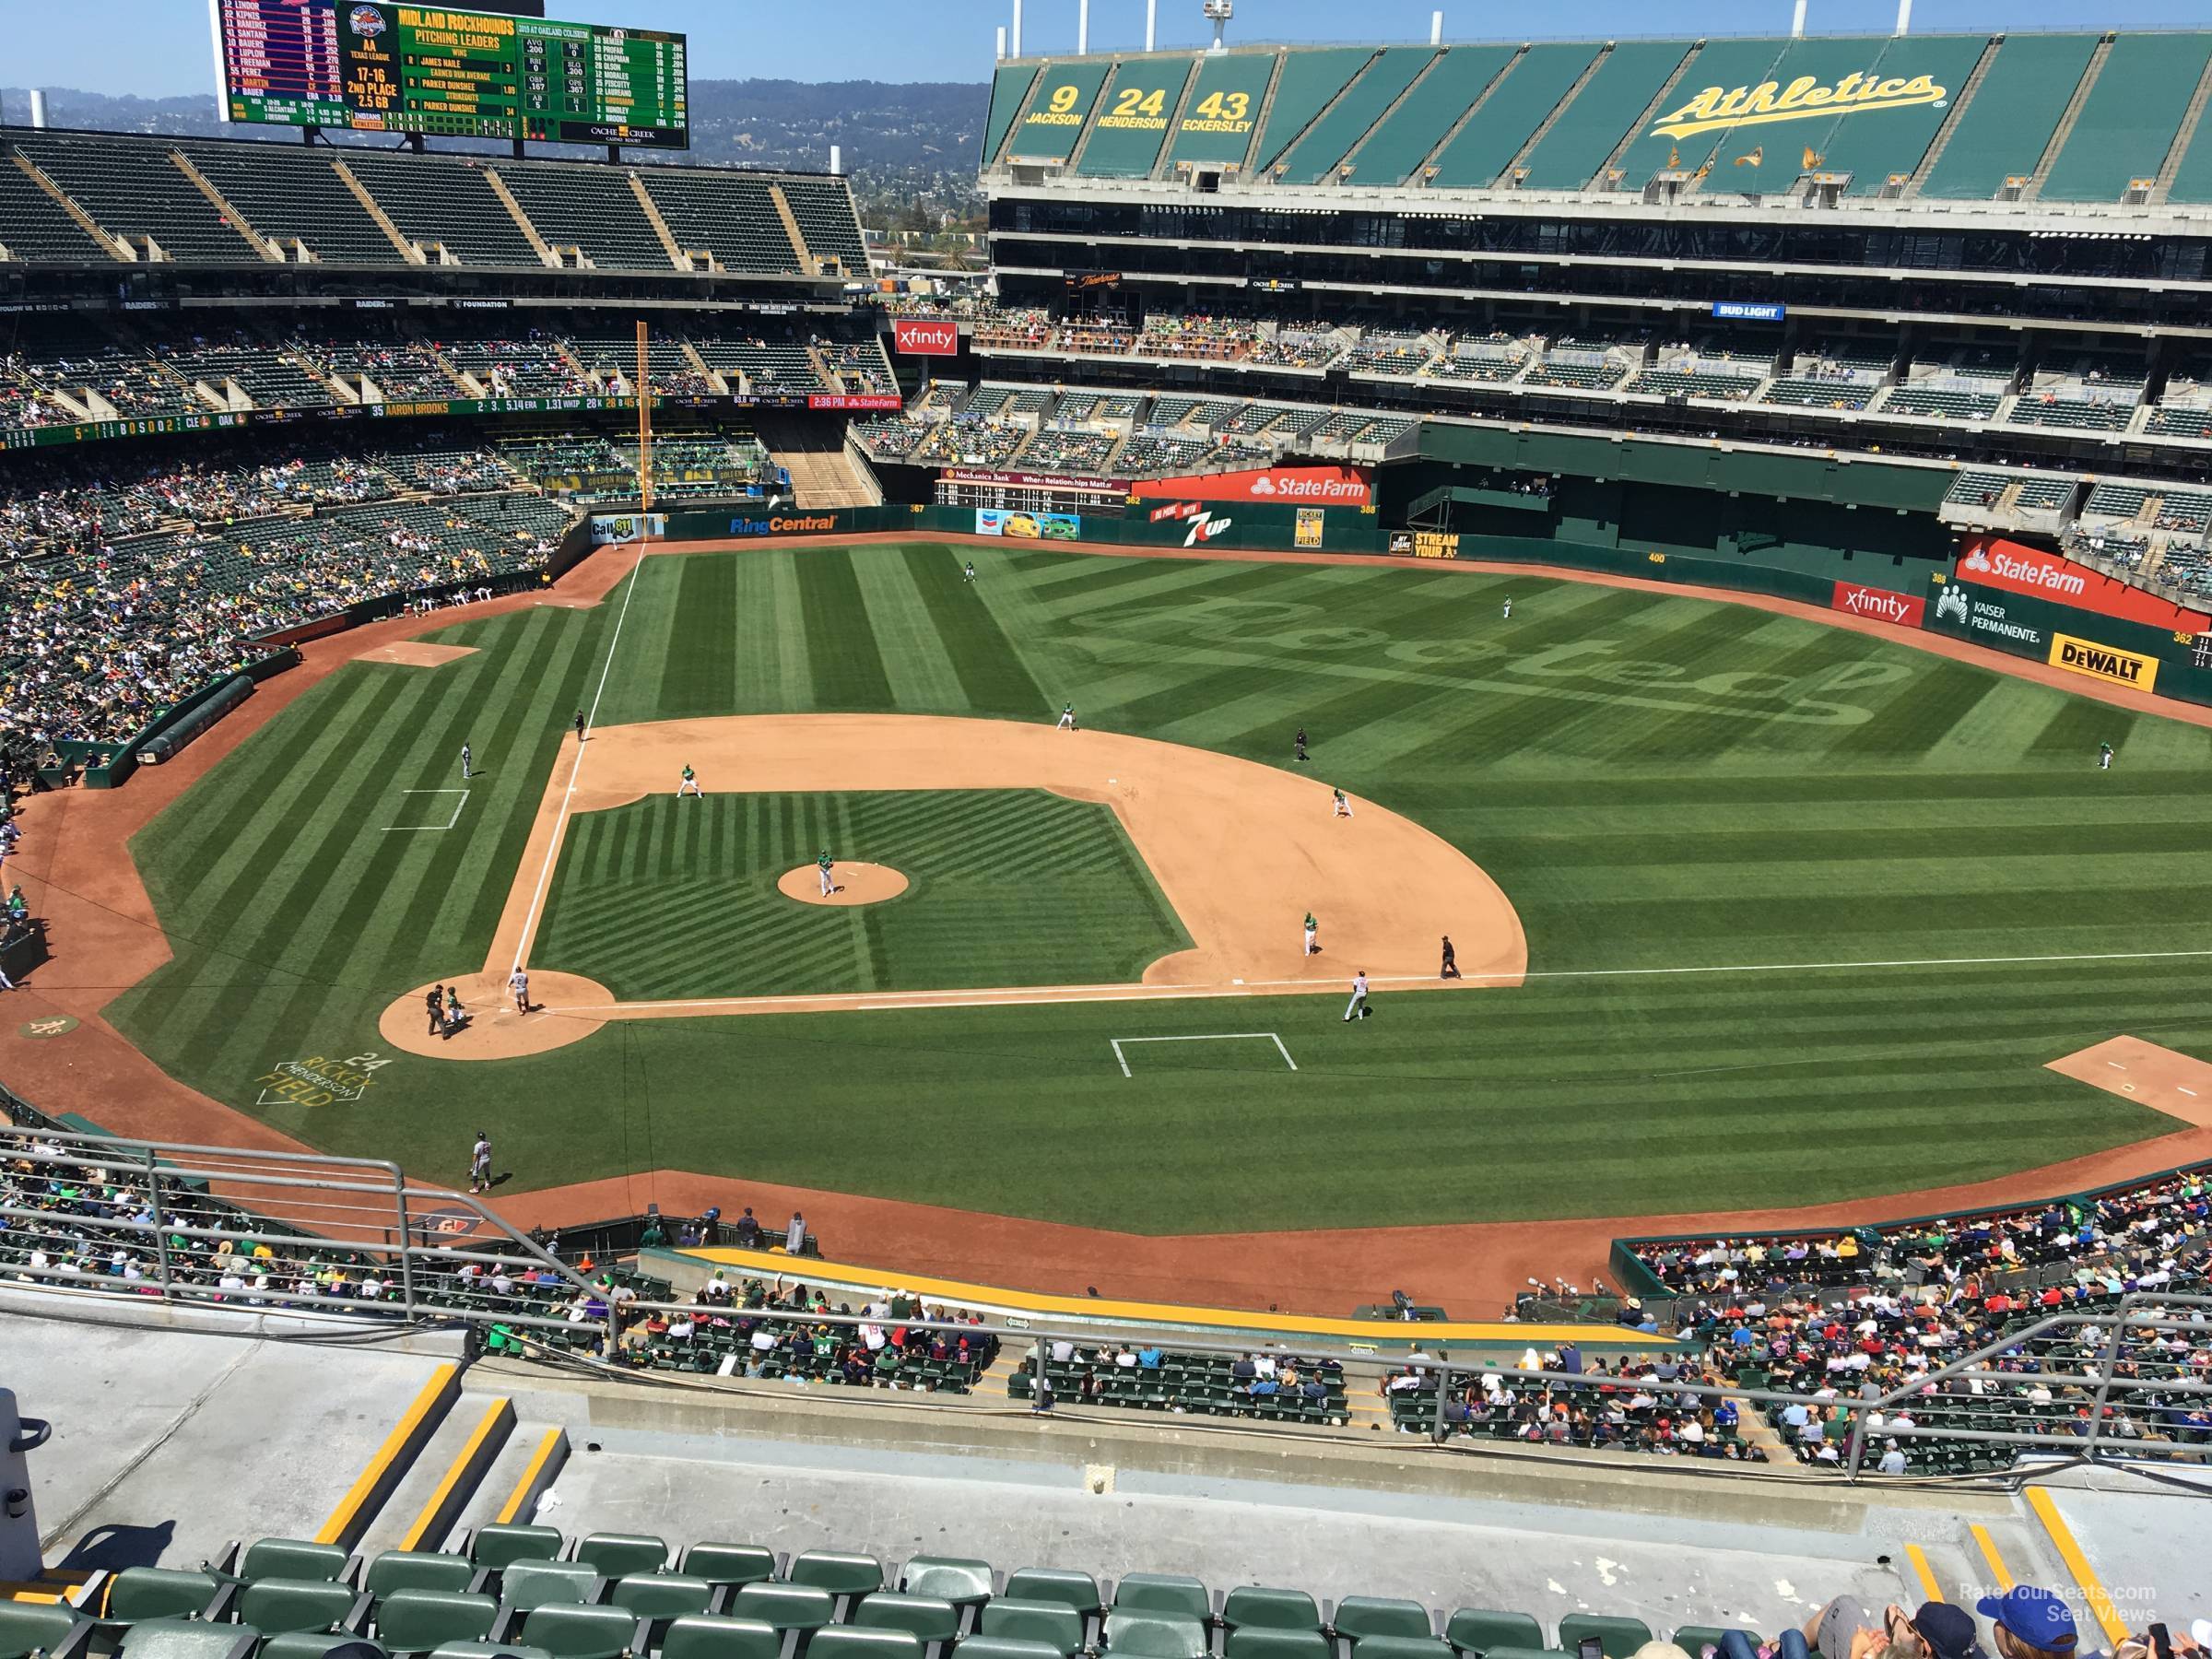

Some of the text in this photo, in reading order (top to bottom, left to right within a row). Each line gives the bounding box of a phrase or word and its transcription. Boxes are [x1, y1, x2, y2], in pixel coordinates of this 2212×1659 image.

[235, 0, 259, 10] LINDOR
[235, 10, 259, 20] KIPNIS
[236, 20, 266, 29] RAMIREZ
[398, 9, 446, 29] MIDLAND
[447, 14, 515, 35] ROCKHOUNDS
[238, 29, 268, 39] SANTANA
[538, 27, 562, 36] OAKLAND
[563, 29, 588, 38] COLISEUM
[227, 38, 264, 48] 10 BAUERS
[415, 29, 500, 49] PITCHING LEADERS
[364, 39, 376, 52] AA
[603, 46, 624, 54] PROFAR
[240, 48, 265, 58] LUPLOW
[350, 51, 390, 61] TEXAS LEAGUE
[452, 49, 467, 57] WINS
[603, 54, 629, 63] CHAPMAN
[241, 58, 314, 71] FREEMAN SS
[421, 57, 442, 67] JAMES
[604, 63, 621, 71] OLSON
[241, 68, 261, 76] PEREZ
[357, 67, 385, 82] 17-16
[431, 69, 491, 81] EARNED RUN AVERAGE
[604, 71, 629, 80] MORALES
[242, 78, 269, 88] MARTIN
[347, 81, 397, 96] 2ND PLACE
[422, 79, 476, 91] PARKER DUNSHEE
[605, 80, 630, 88] PISCOTTY
[243, 88, 264, 97] BAUER
[446, 92, 479, 101] STRIKEOUTS
[605, 88, 631, 97] LAUREANO
[359, 95, 388, 108] 2.5 GB
[1050, 86, 1078, 112] 9
[1113, 89, 1165, 116] 24
[1650, 71, 1947, 139] Athletics
[424, 101, 447, 111] PARKER
[449, 103, 477, 113] DUNSHEE
[606, 106, 629, 114] HUNDLEY
[1196, 92, 1249, 120] 43
[354, 112, 381, 120] INDIANS
[1026, 112, 1082, 125] JACKSON
[1098, 116, 1167, 129] HENDERSON
[1182, 119, 1253, 133] ECKERSLEY
[591, 127, 617, 135] CACHE
[1720, 306, 1777, 317] BUD LIGHT
[900, 328, 953, 348] xfinity
[372, 406, 383, 417] 35
[386, 404, 413, 417] AARON
[415, 403, 448, 415] BROOKS
[506, 400, 524, 411] 5.14
[546, 399, 562, 410] 1.31
[563, 400, 580, 408] WHIP
[586, 398, 597, 409] 28
[606, 398, 616, 408] 28
[624, 398, 635, 408] 45
[815, 397, 845, 406] 2:36 PM
[139, 422, 145, 433] S
[167, 419, 173, 431] 2
[186, 417, 199, 428] CLE
[218, 415, 234, 426] OAK
[75, 427, 82, 440] 5
[956, 471, 991, 481] Mechanics
[1023, 476, 1043, 484] Wher
[1126, 496, 1141, 505] 362
[910, 504, 924, 513] 367
[1155, 504, 1197, 520] DO MORE WITH
[1360, 506, 1376, 514] 388
[593, 519, 631, 535] Call 811
[730, 515, 835, 535] RingCentral
[1297, 536, 1320, 545] FIELD
[1416, 533, 1459, 547] STREAM
[1415, 545, 1442, 557] YOUR
[1649, 553, 1665, 563] 400
[1932, 572, 1947, 584] 388
[1846, 588, 1910, 622] xfinity
[1974, 601, 2005, 619] KAISER
[1971, 617, 2038, 642] PERMANENTE
[2174, 631, 2192, 645] 362
[344, 1052, 394, 1071] 24
[301, 1056, 378, 1088] RICKEY
[286, 1064, 354, 1097] HENDERSON
[254, 1072, 333, 1106] FIELD
[818, 1345, 830, 1354] 24
